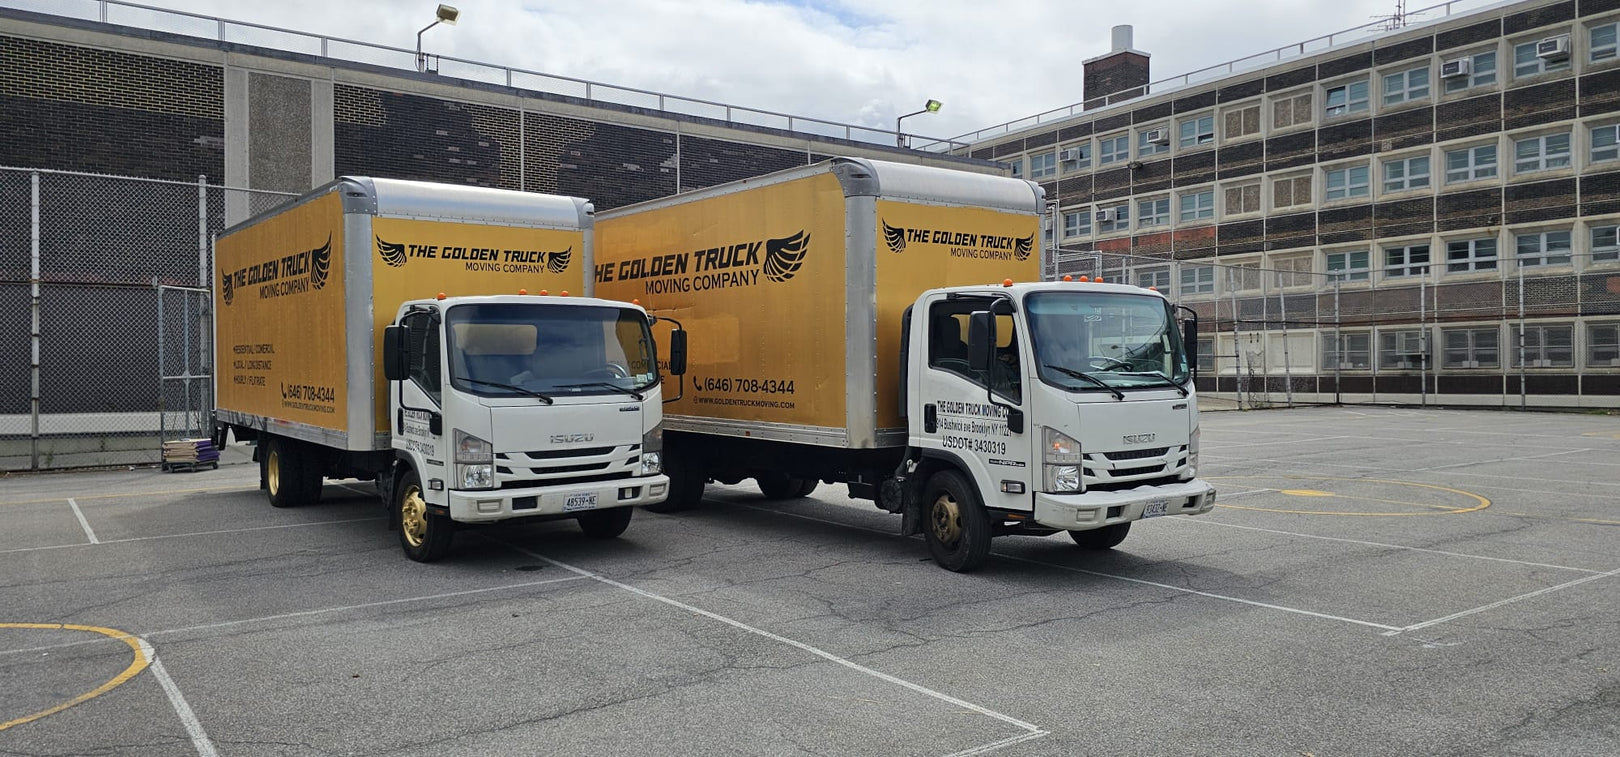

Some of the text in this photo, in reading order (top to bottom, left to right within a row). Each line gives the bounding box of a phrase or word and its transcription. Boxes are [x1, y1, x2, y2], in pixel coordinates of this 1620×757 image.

[907, 229, 1013, 250] THE GOLDEN TRUCK
[408, 244, 546, 263] THE GOLDEN TRUCK
[595, 241, 762, 283] HE GOLDEN TRUCK
[950, 248, 1012, 260] MOVING COMPANY
[234, 250, 311, 289] THE GOLDEN TRUCK
[465, 262, 545, 274] MOVING COMPANY
[260, 277, 310, 300] MOVING COMPANY
[645, 269, 760, 295] MOVING COMPANY
[288, 384, 335, 403] (646) 708-4344
[704, 377, 795, 395] (646) 708-4344
[699, 398, 795, 409] WWW.GOLDENTRUCKMOVING.COM
[938, 401, 946, 412] THE
[947, 402, 964, 414] GOLDEN
[966, 403, 980, 416] TRUCK
[982, 404, 1001, 418] MOVING
[944, 418, 962, 431] Bushwick
[972, 421, 990, 437] Brooklyn
[991, 423, 998, 435] NY
[550, 434, 594, 444] ISUZU
[943, 435, 1006, 455] USDOT# 3430319
[1123, 433, 1155, 444] ISUZU
